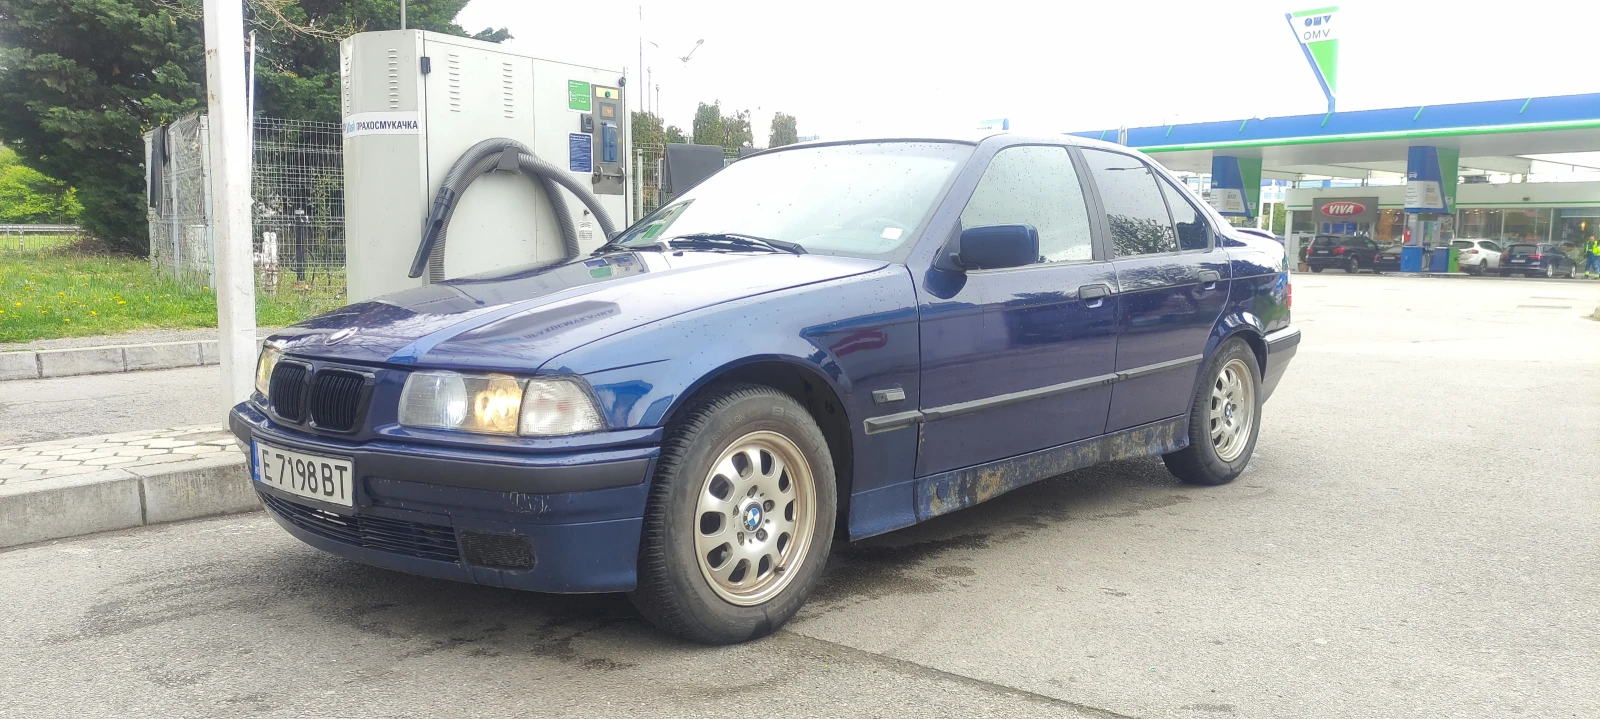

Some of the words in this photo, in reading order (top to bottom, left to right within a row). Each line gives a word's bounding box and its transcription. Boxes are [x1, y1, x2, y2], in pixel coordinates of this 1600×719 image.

[1304, 15, 1332, 27] OMV
[1303, 29, 1331, 41] OMV
[356, 120, 418, 131] ПРАХОСМУКАЧКА
[1329, 205, 1355, 214] VIVA
[712, 412, 746, 443] ROTATION
[262, 448, 272, 481] E
[275, 453, 318, 494] 7198
[321, 462, 348, 500] BT
